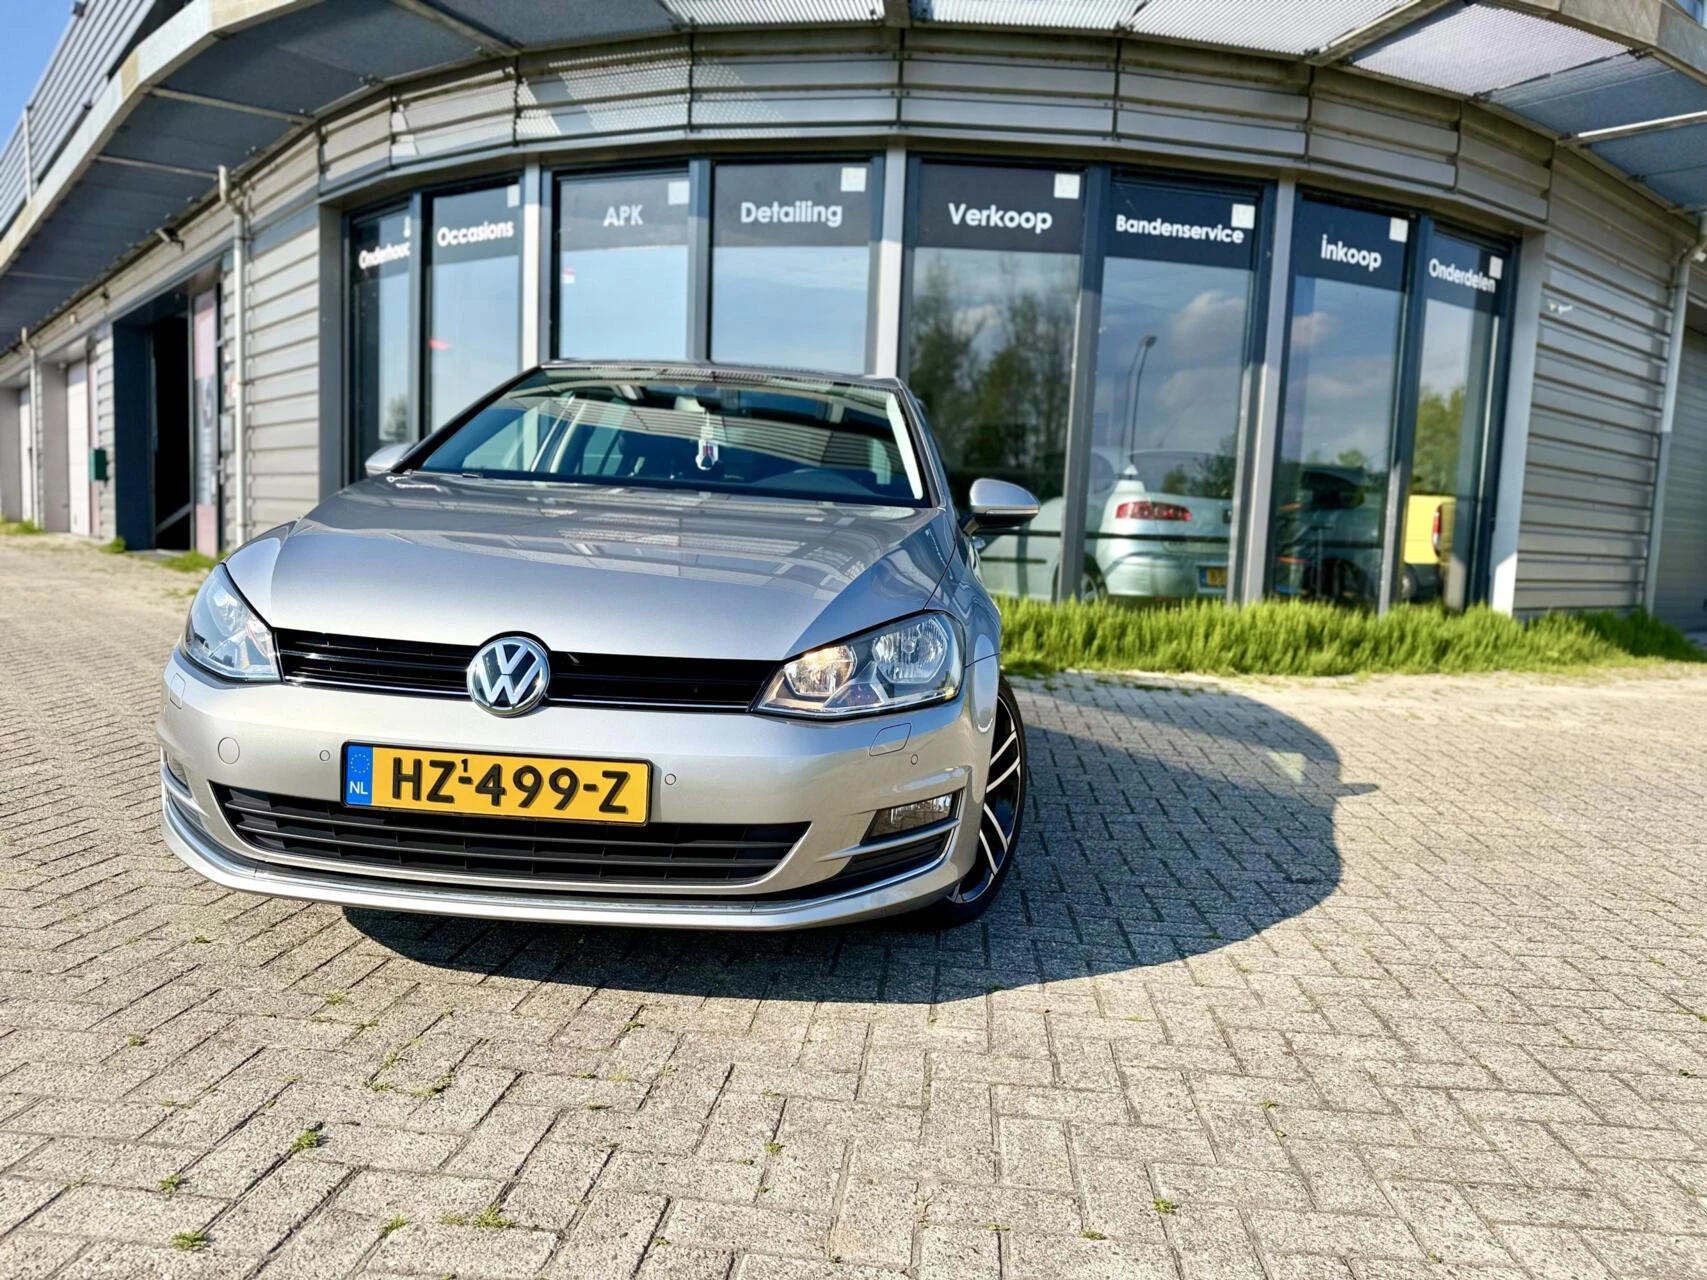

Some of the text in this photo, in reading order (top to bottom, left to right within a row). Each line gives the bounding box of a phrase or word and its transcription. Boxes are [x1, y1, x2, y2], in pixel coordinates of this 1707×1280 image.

[603, 205, 644, 227] APK
[741, 201, 843, 228] Detailing
[948, 203, 1053, 234] Verkoop
[437, 220, 514, 247] Occasions
[1116, 214, 1244, 244] Bandenservice
[1428, 258, 1496, 293] Onderdelen
[350, 780, 369, 796] NL
